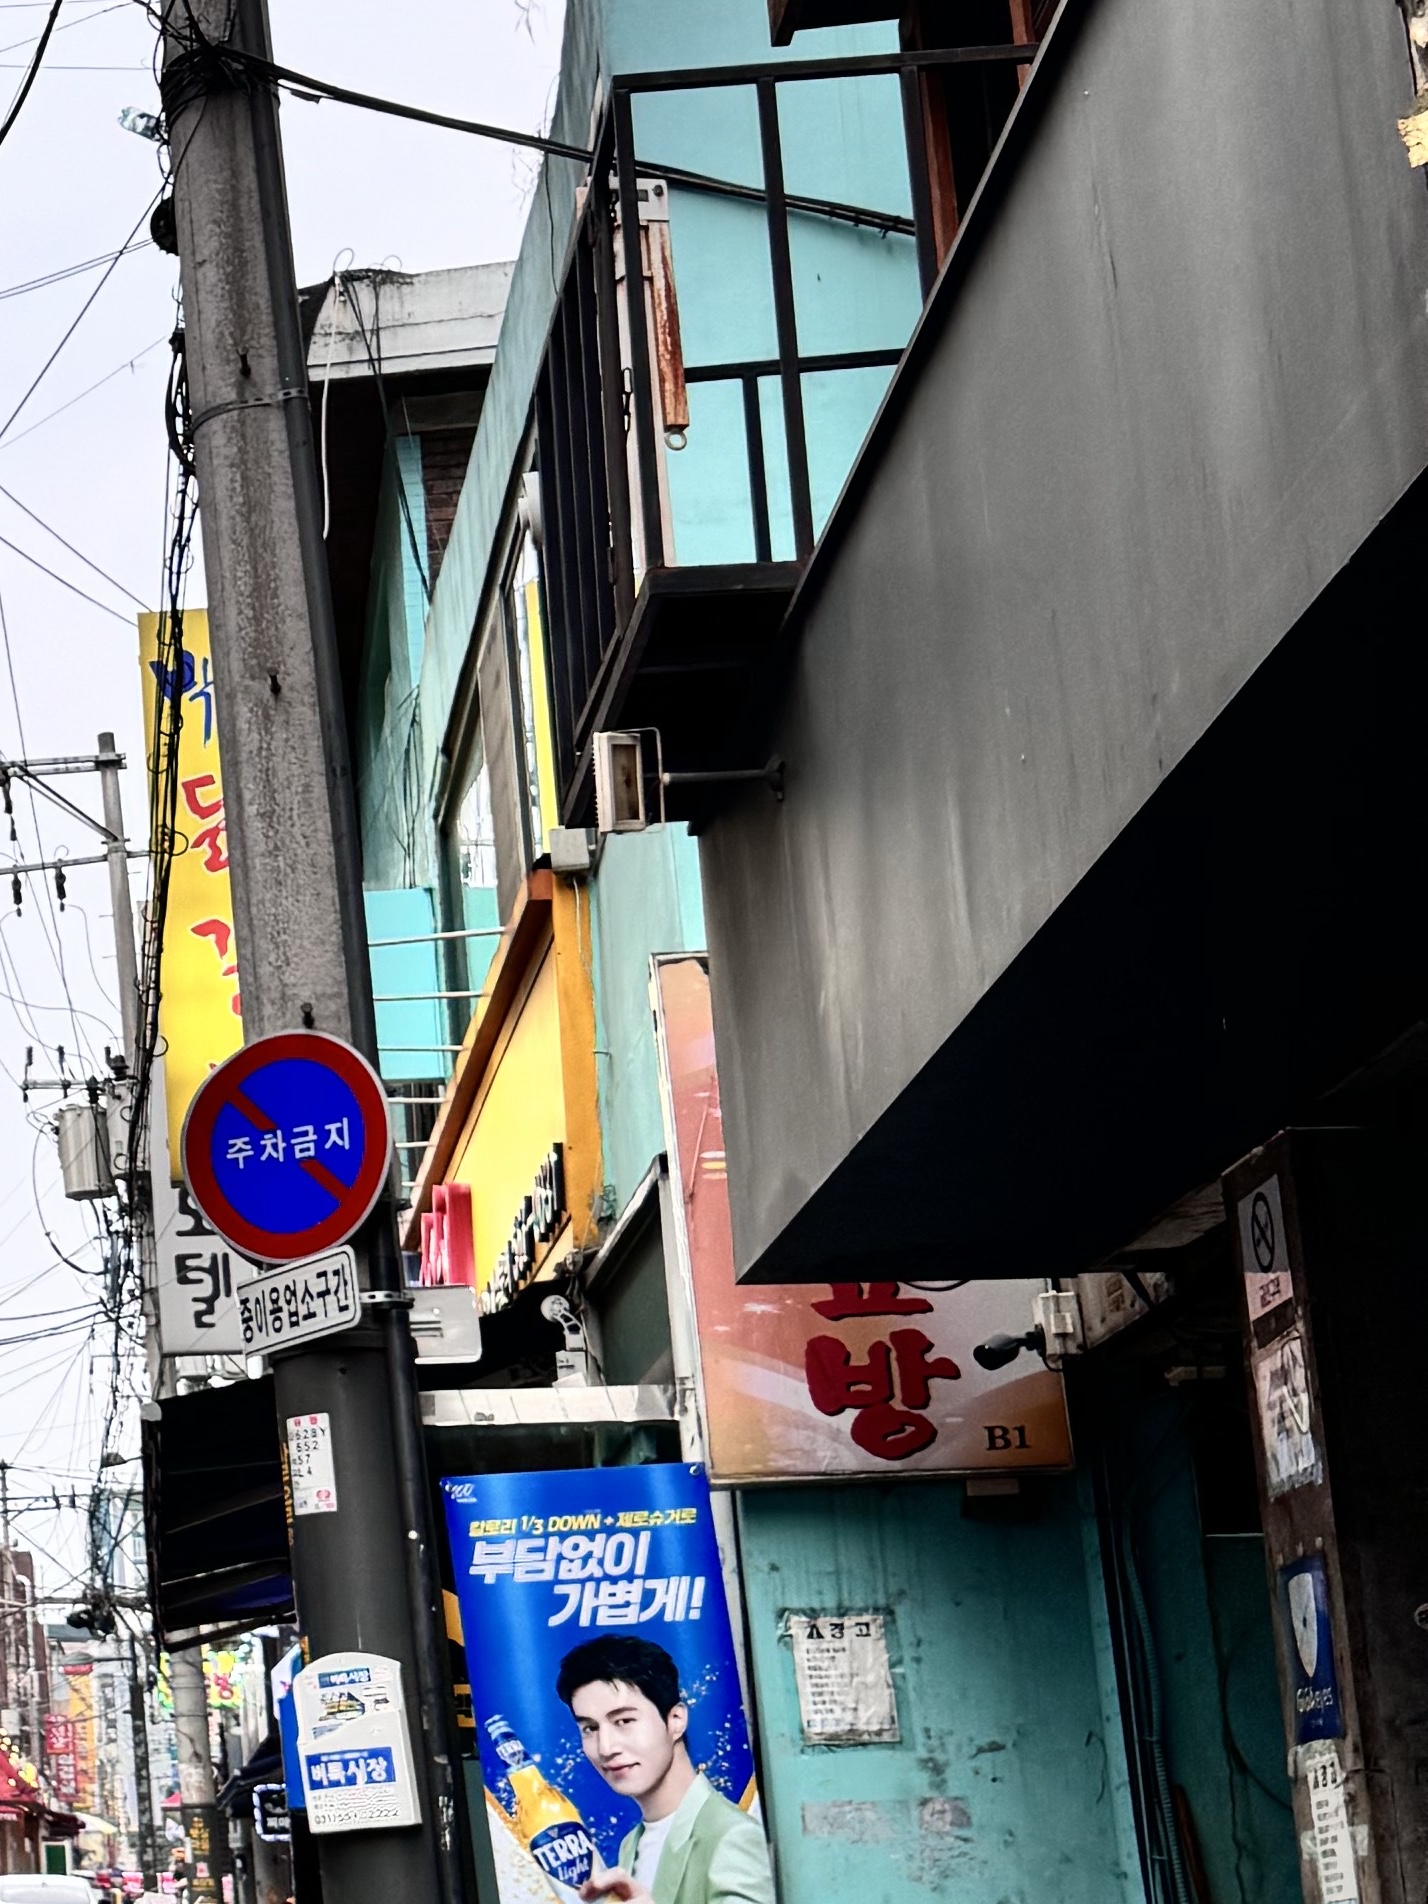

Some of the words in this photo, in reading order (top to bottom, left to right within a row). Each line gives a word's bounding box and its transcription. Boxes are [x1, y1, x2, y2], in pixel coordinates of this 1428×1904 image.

[226, 1117, 350, 1169] 주차금지
[985, 1424, 1032, 1452] B1
[521, 1514, 543, 1533] 1/3
[548, 1512, 601, 1532] DOWN
[468, 1530, 651, 1584] 부담없이
[547, 1575, 704, 1628] 가볍게!
[534, 1828, 593, 1867] TERRA
